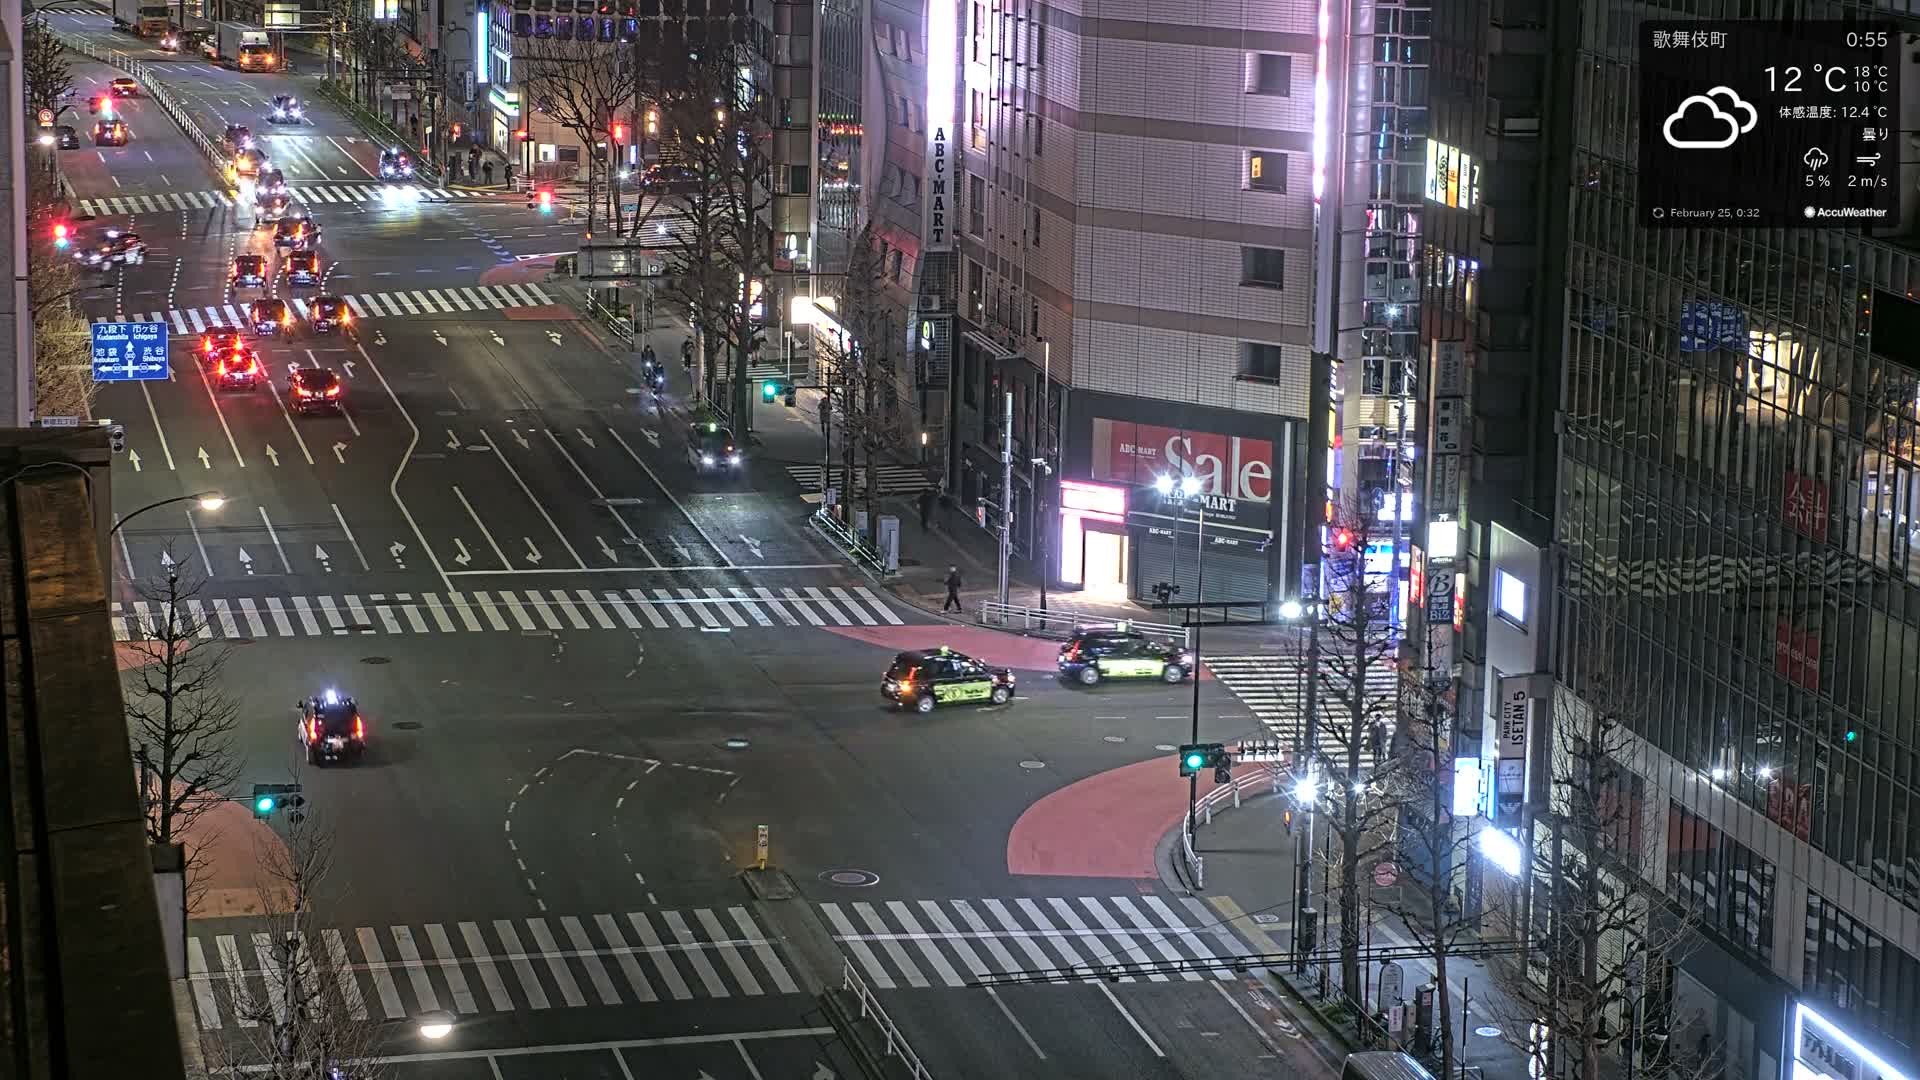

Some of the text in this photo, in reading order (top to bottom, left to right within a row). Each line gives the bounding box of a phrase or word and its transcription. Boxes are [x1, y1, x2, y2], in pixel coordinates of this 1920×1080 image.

[98, 324, 127, 334] 九段下
[1164, 435, 1272, 503] Sale
[1503, 701, 1511, 739] PARK CITY
[1512, 690, 1525, 745] ISETAN 5
